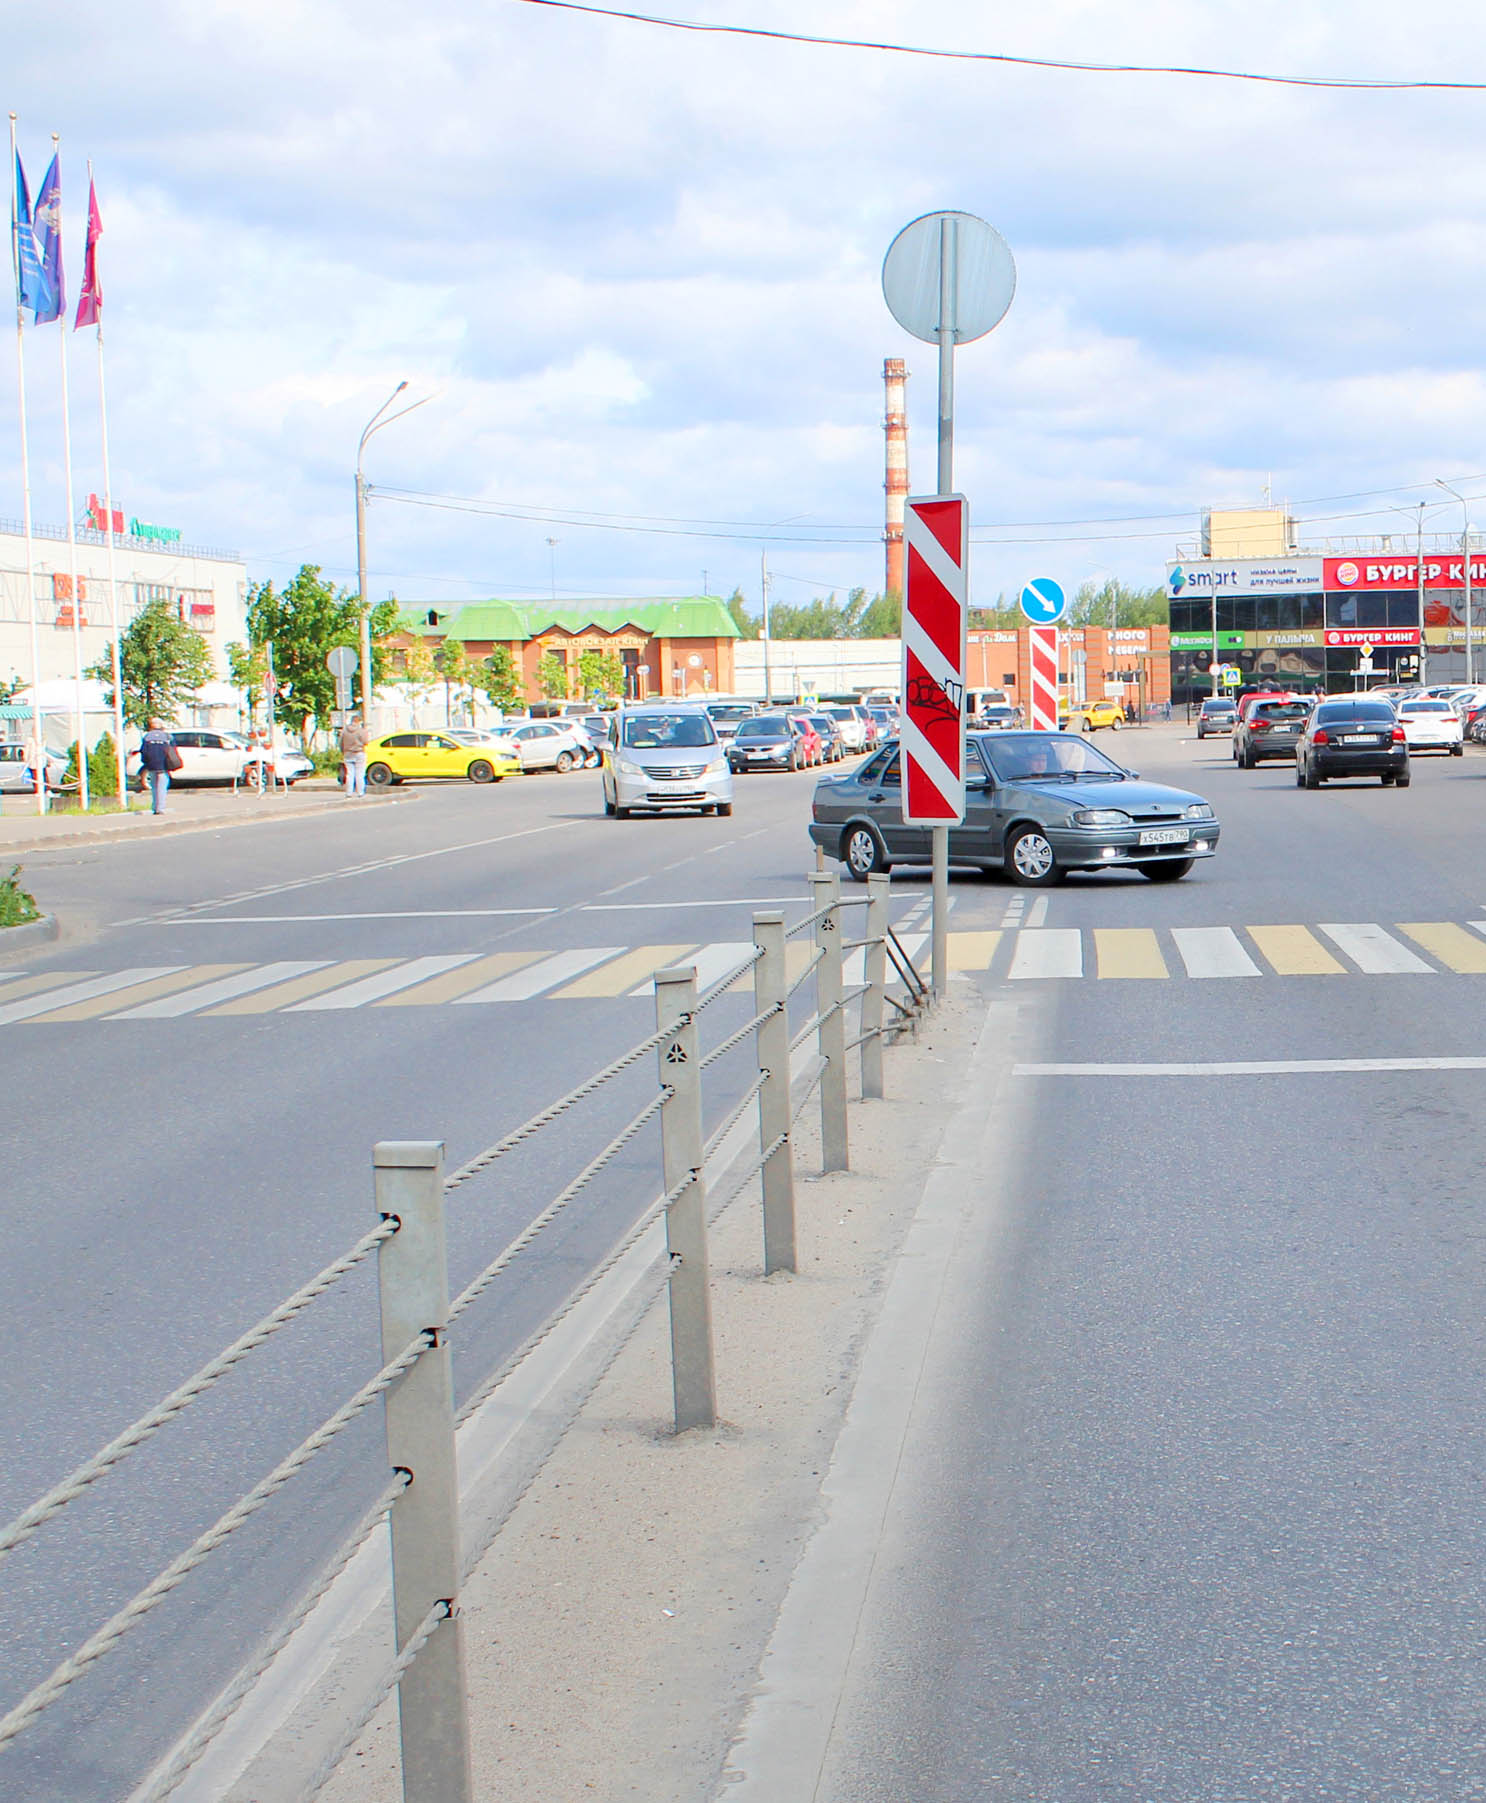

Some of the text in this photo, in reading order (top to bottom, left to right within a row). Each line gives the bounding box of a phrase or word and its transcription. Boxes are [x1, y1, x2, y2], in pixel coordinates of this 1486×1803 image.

[1366, 564, 1442, 582] БУРГЕР
[1274, 634, 1316, 644] ПАЛЫЧА
[1343, 633, 1382, 642] БУРГЕР
[1385, 632, 1414, 641] КИНГ
